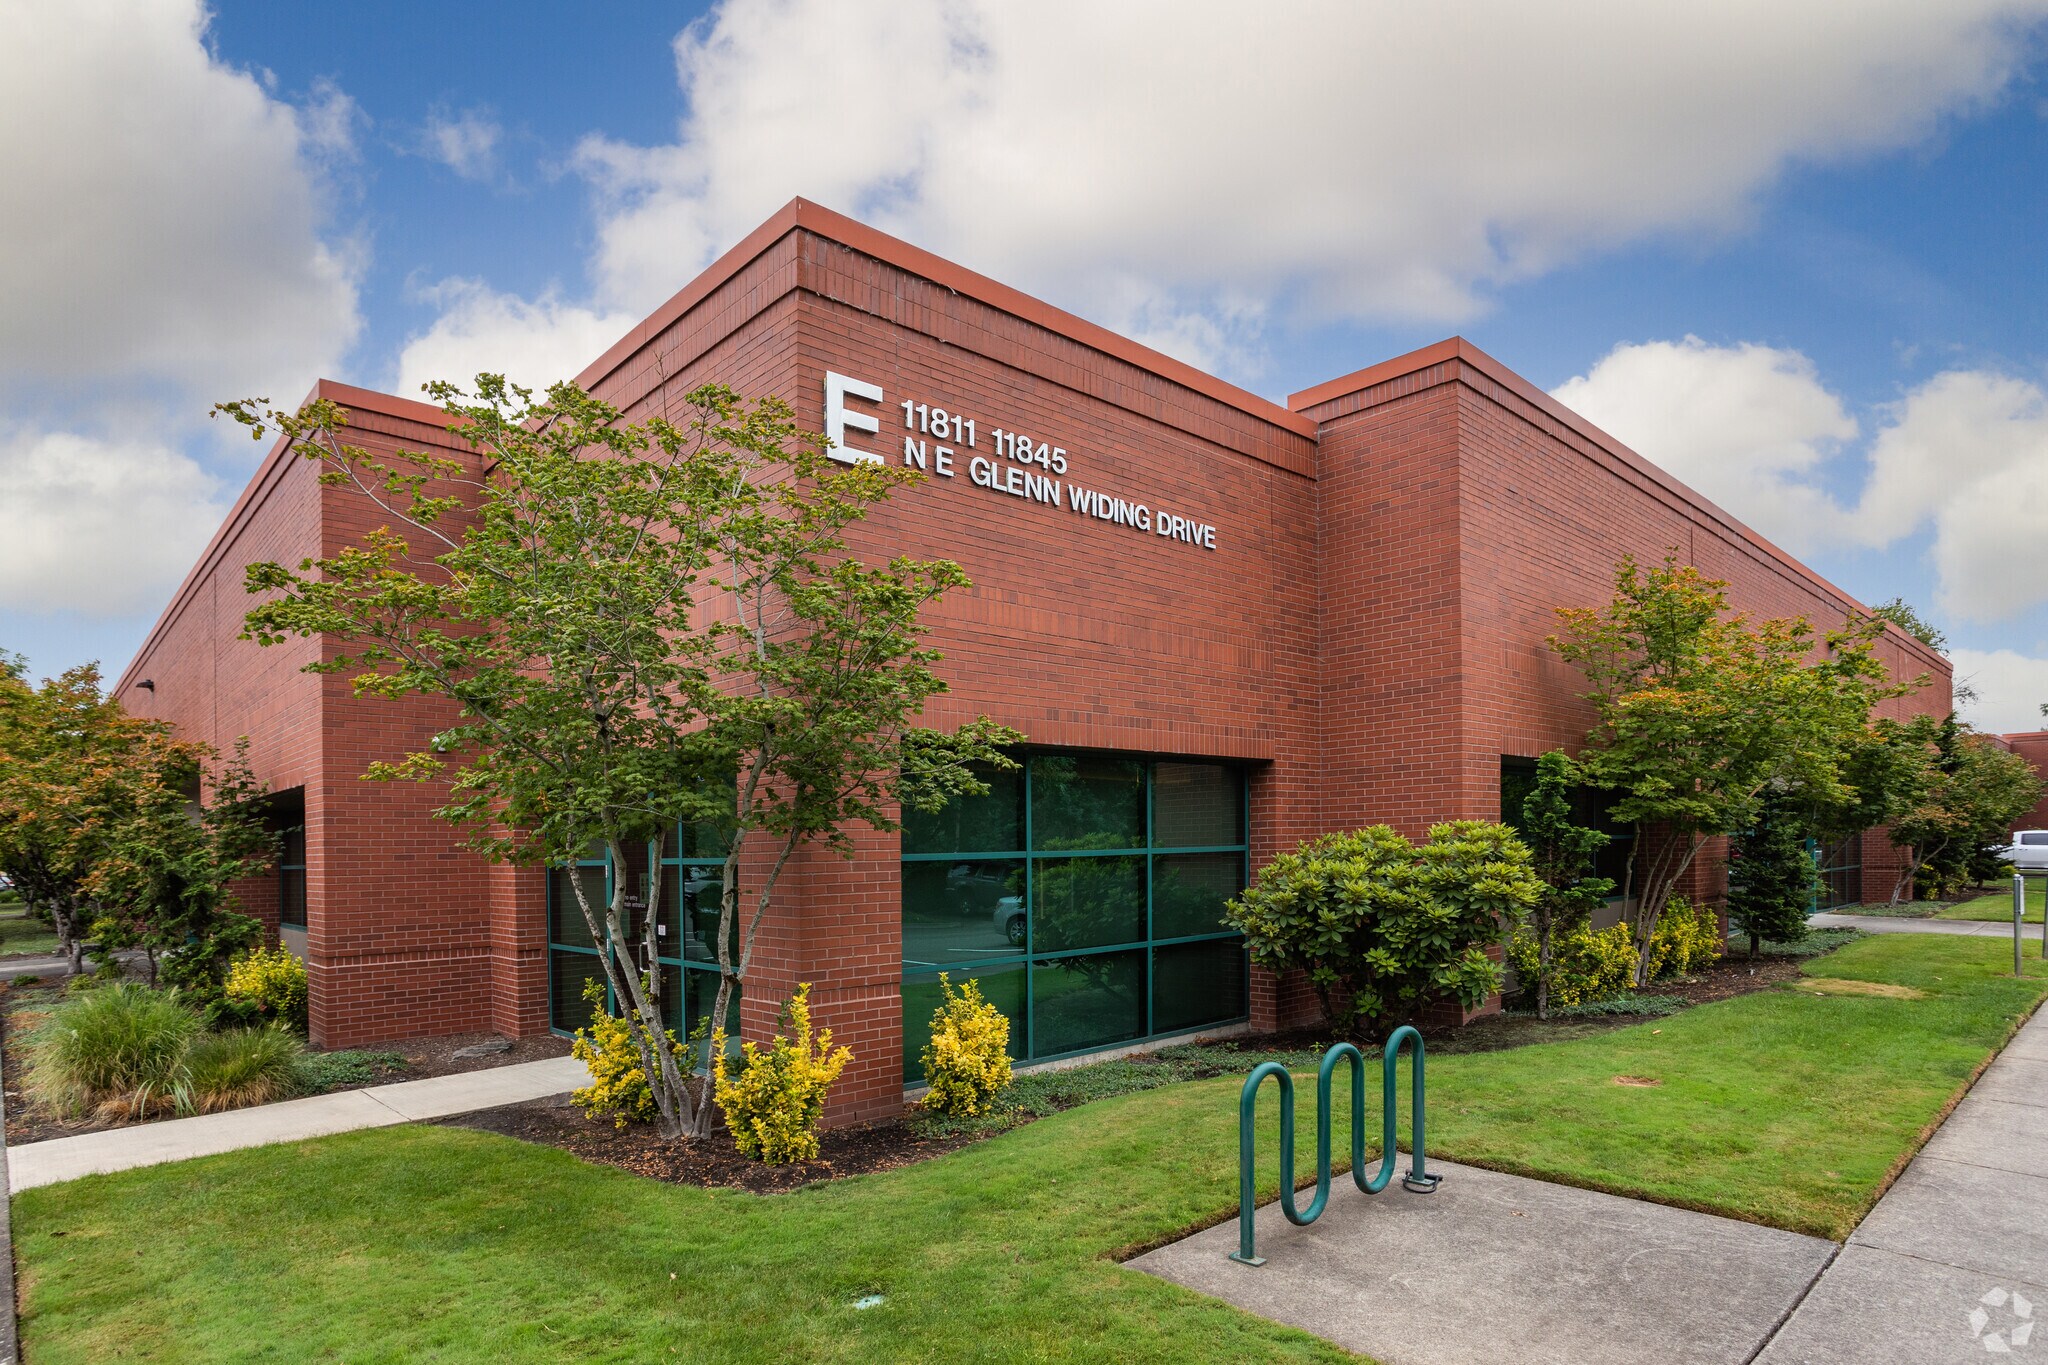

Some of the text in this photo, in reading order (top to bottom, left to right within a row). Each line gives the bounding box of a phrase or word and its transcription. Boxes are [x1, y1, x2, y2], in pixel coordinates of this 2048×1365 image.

[825, 370, 885, 466] E
[901, 399, 1067, 475] 11811 11845
[970, 456, 1060, 506] GLENN
[1068, 484, 1150, 531] WIDING
[1157, 510, 1216, 550] DRIVE
